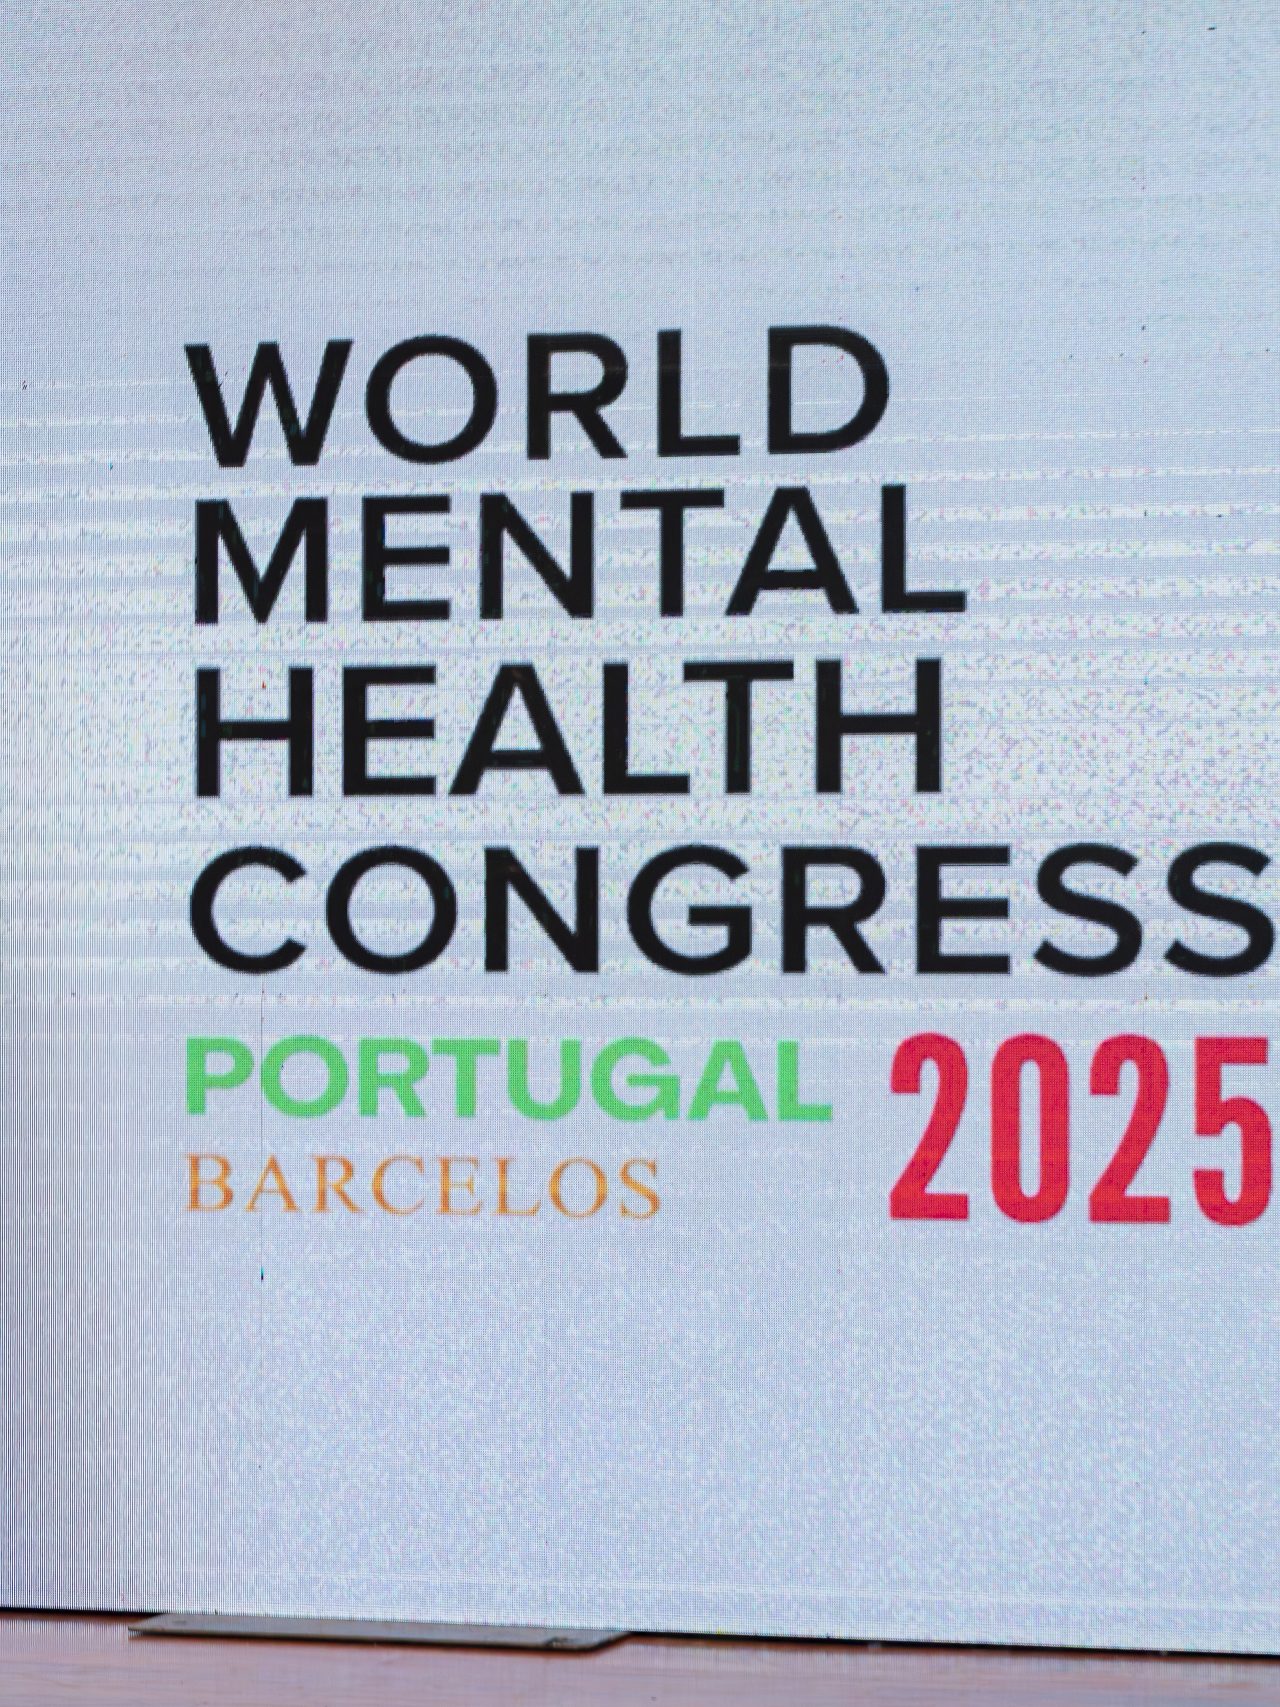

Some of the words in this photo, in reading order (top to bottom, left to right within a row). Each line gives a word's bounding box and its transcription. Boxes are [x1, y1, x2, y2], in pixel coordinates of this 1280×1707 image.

[184, 326, 889, 468] WORLD
[195, 484, 967, 623] MENTAL
[197, 659, 941, 797] HEALTH
[190, 842, 1275, 976] CONGRESS
[187, 1036, 831, 1121] PORTUGAL
[889, 1032, 1272, 1226] 2025
[188, 1155, 660, 1218] BARCELOS
